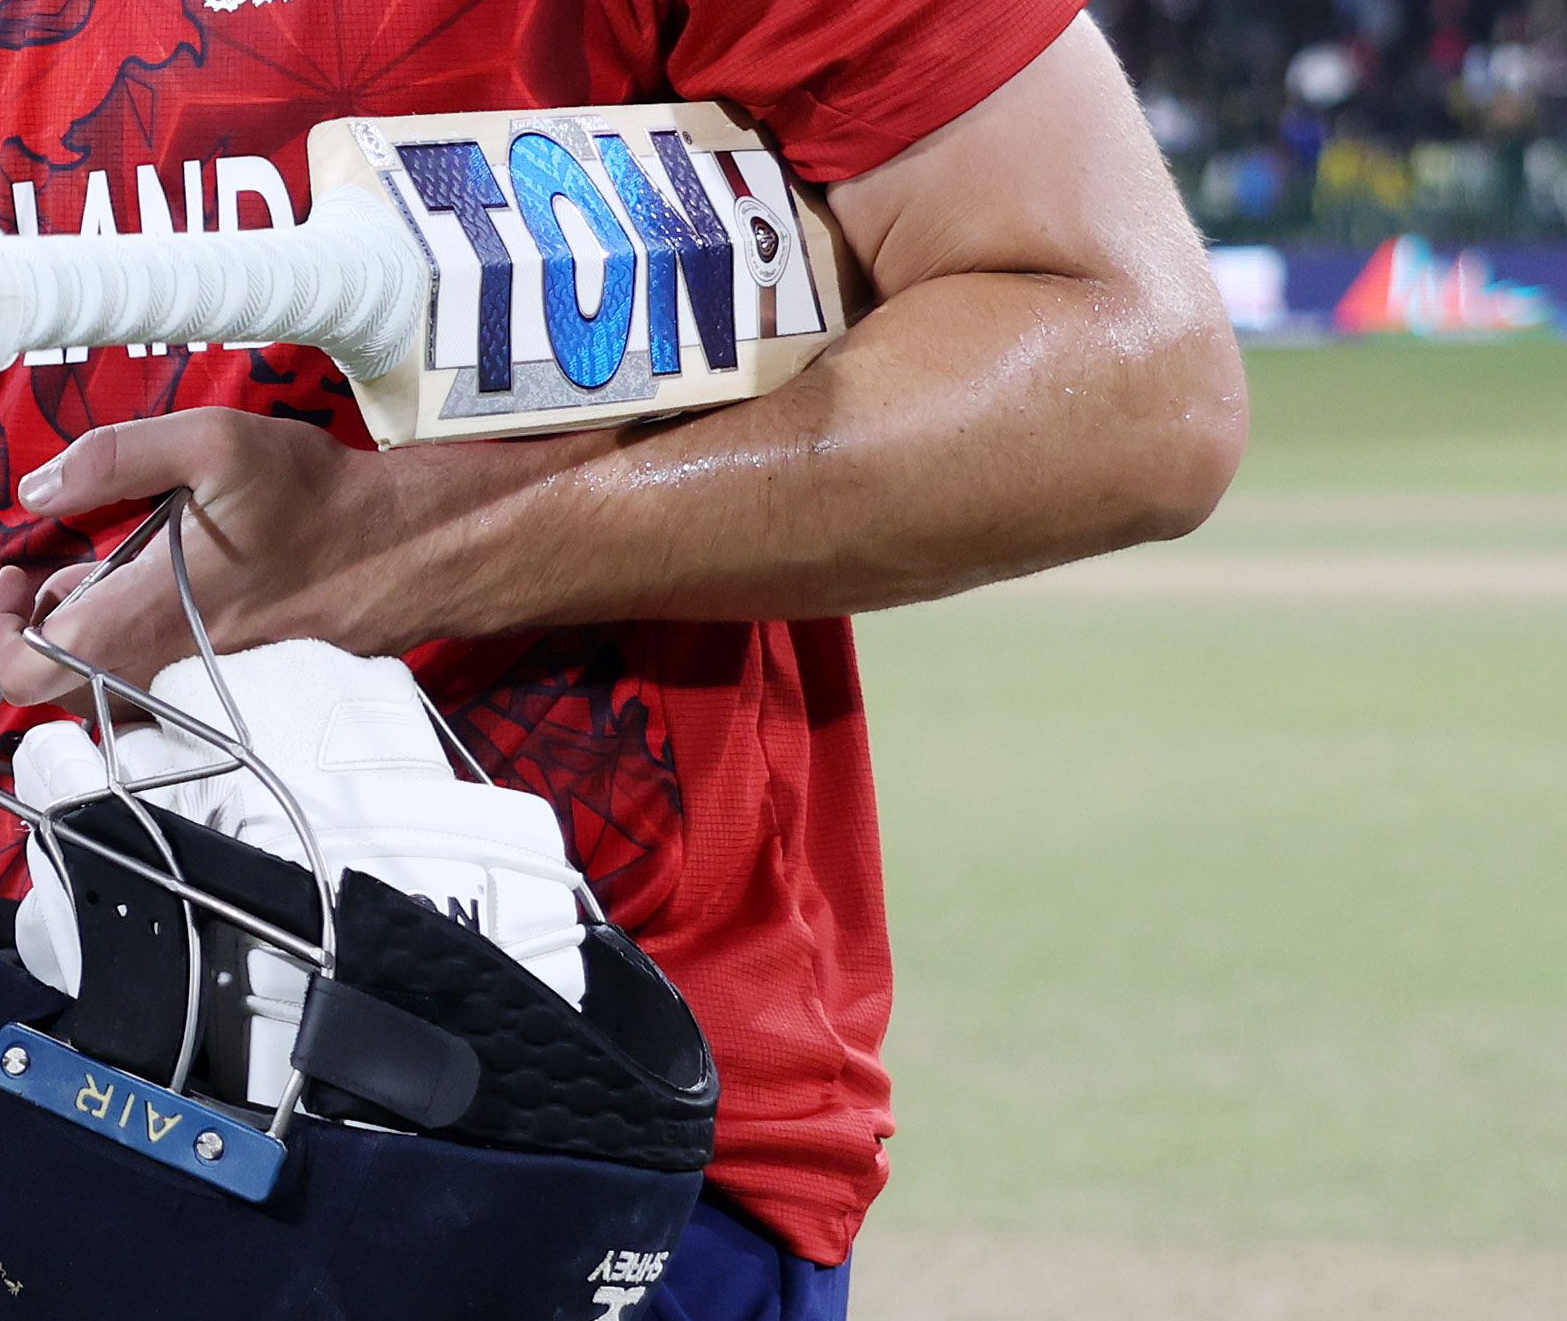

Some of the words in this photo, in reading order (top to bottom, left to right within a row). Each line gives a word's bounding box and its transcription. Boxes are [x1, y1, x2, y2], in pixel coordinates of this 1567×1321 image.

[394, 127, 741, 394] TON
[75, 1071, 184, 1142] AIR
[586, 1249, 670, 1285] SHREY
